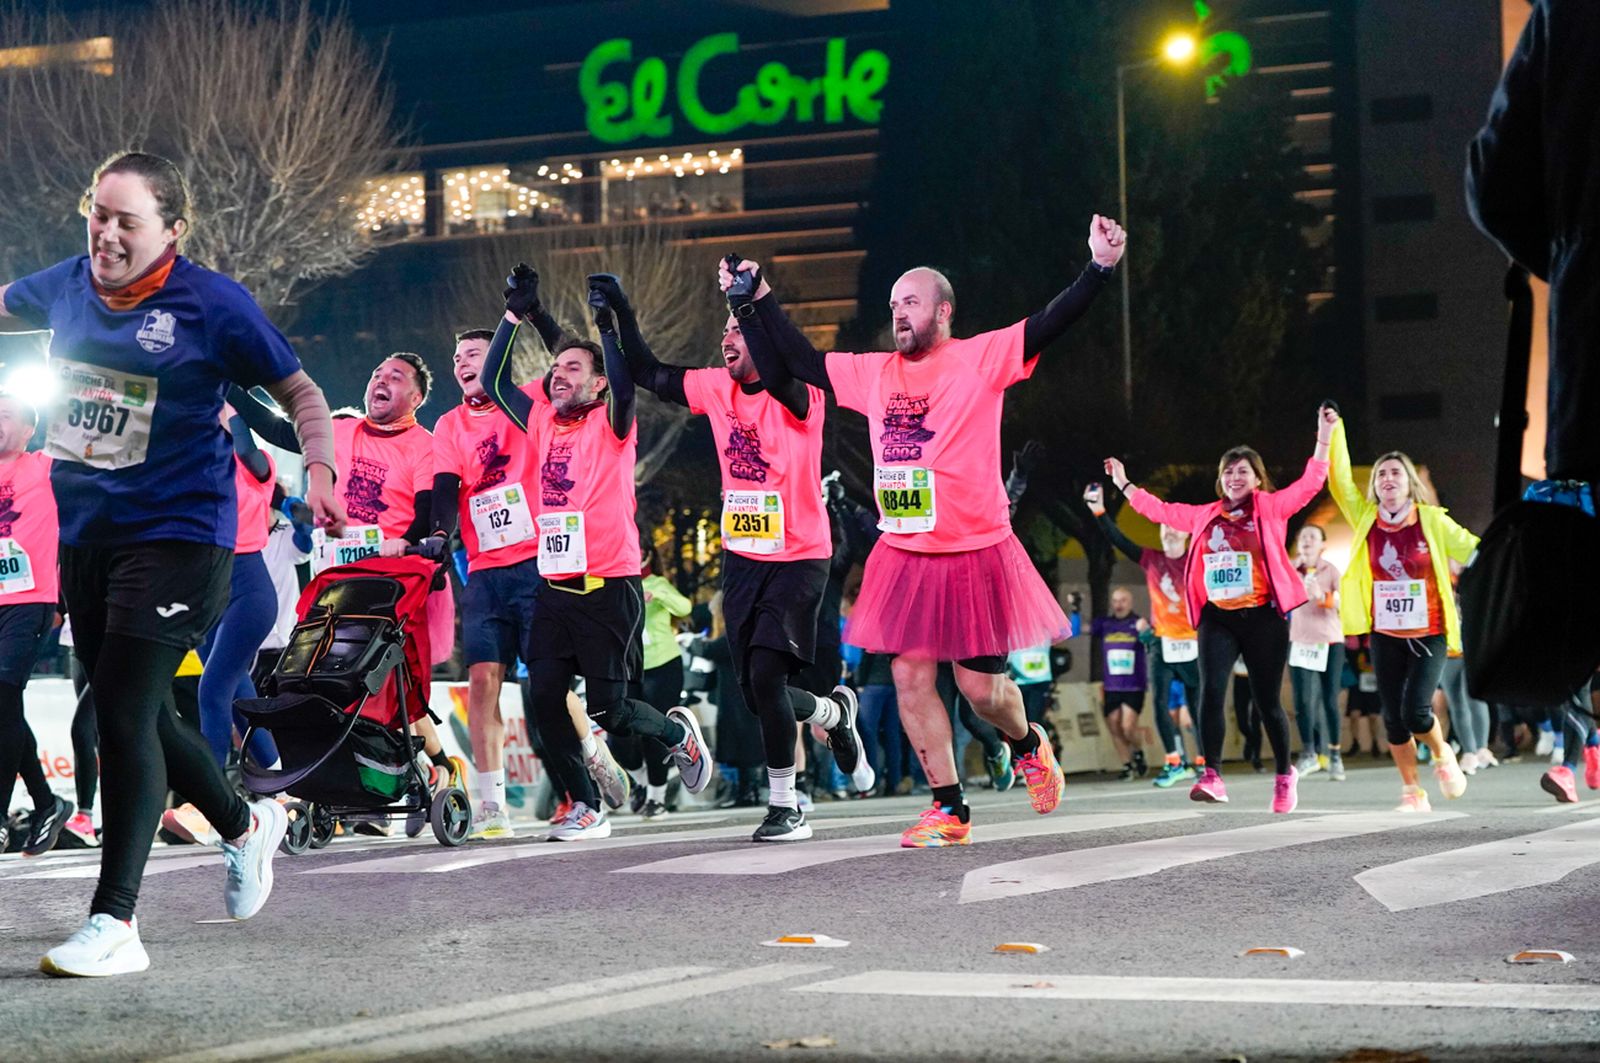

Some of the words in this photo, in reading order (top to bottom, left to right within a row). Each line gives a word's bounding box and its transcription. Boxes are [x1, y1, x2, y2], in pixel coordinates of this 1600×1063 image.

[579, 38, 673, 144] El
[677, 32, 891, 135] Corte
[68, 398, 130, 437] 3967
[884, 447, 920, 459] 500€
[883, 490, 922, 510] 8844
[488, 508, 512, 530] 132
[732, 513, 770, 532] 2351
[546, 534, 570, 553] 4167
[1212, 568, 1242, 584] 4062
[1385, 598, 1414, 613] 4977
